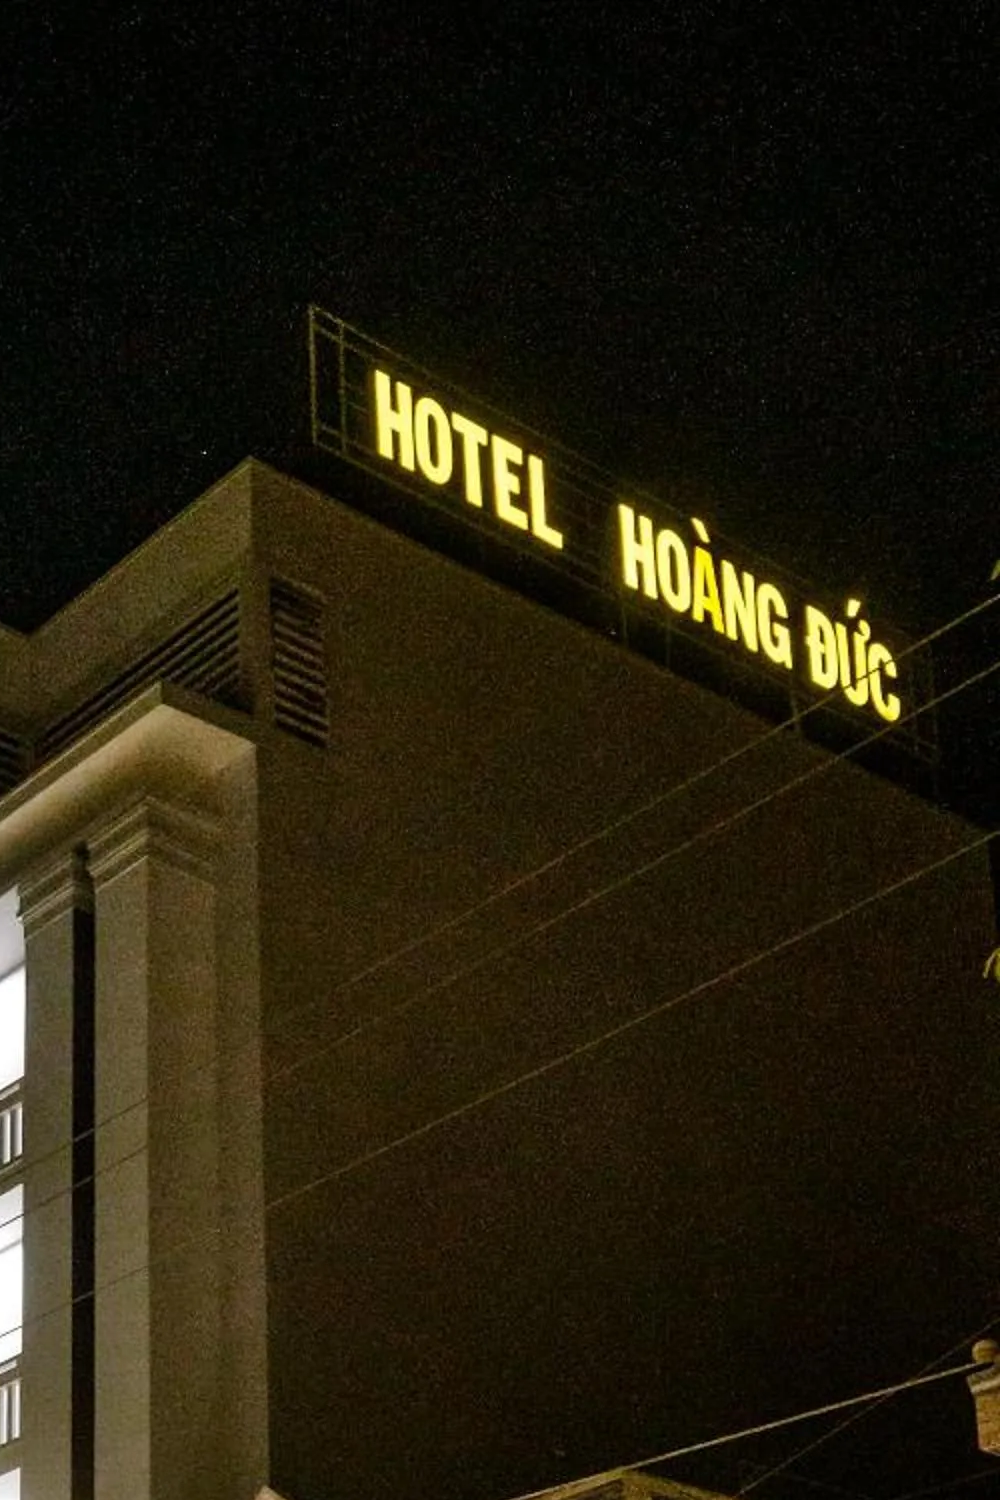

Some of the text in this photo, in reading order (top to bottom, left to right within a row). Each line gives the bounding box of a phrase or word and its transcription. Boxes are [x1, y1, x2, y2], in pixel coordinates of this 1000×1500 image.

[374, 368, 900, 722] HOTEL HOÀNG ĐỨC
